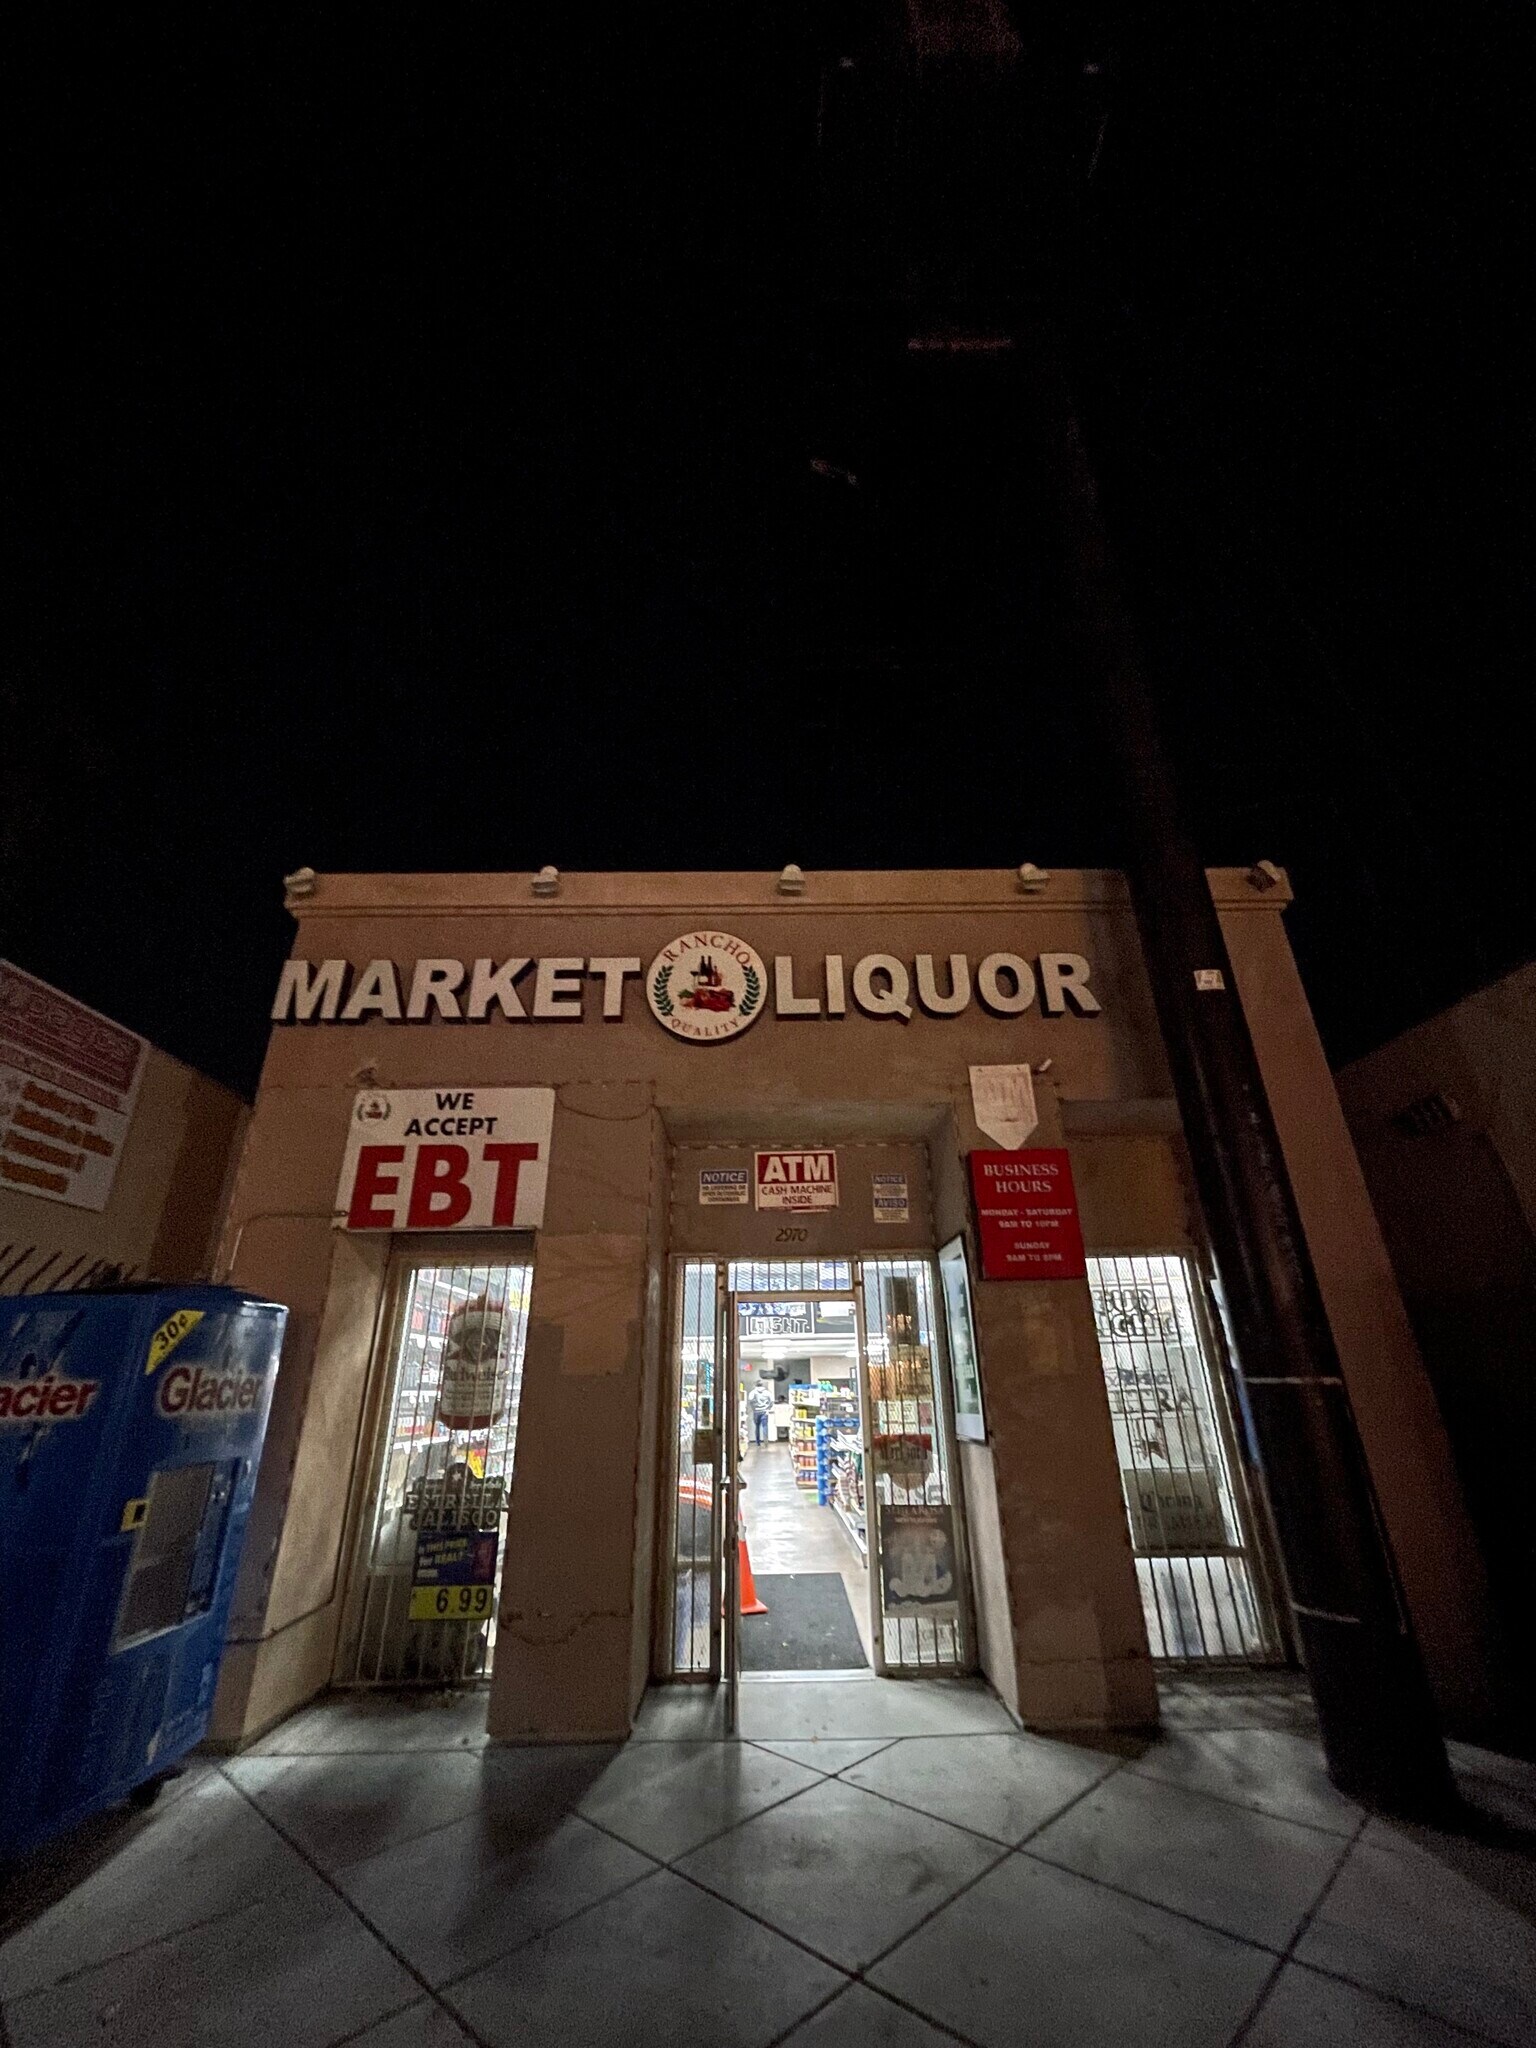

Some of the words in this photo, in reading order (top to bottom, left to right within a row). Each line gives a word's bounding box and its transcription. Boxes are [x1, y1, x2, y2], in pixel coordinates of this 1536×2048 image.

[662, 934, 752, 967] RANCHO
[270, 957, 641, 1021] MARKET
[775, 953, 1102, 1020] LIQUOR
[671, 1018, 739, 1037] QUALITY
[435, 1092, 475, 1111] WE
[403, 1117, 498, 1136] ACCEPT
[702, 1172, 746, 1183] NOTICE
[763, 1155, 830, 1182] ATM
[983, 1163, 1059, 1177] BUSINESS
[347, 1142, 539, 1229] EBT
[761, 1185, 788, 1196] CASH
[790, 1184, 832, 1195] MACHINE
[995, 1180, 1053, 1193] HOURS
[782, 1195, 812, 1204] INSIDE
[981, 1208, 1019, 1217] MONDAY
[1025, 1207, 1073, 1216] SATURDAY
[1020, 1220, 1033, 1228] TO
[775, 1227, 808, 1242] 2970
[1014, 1242, 1051, 1250] SUNDAY
[154, 1314, 189, 1350] 30¢
[160, 1366, 265, 1414] Glacier
[405, 1493, 510, 1510] ESTRELLA
